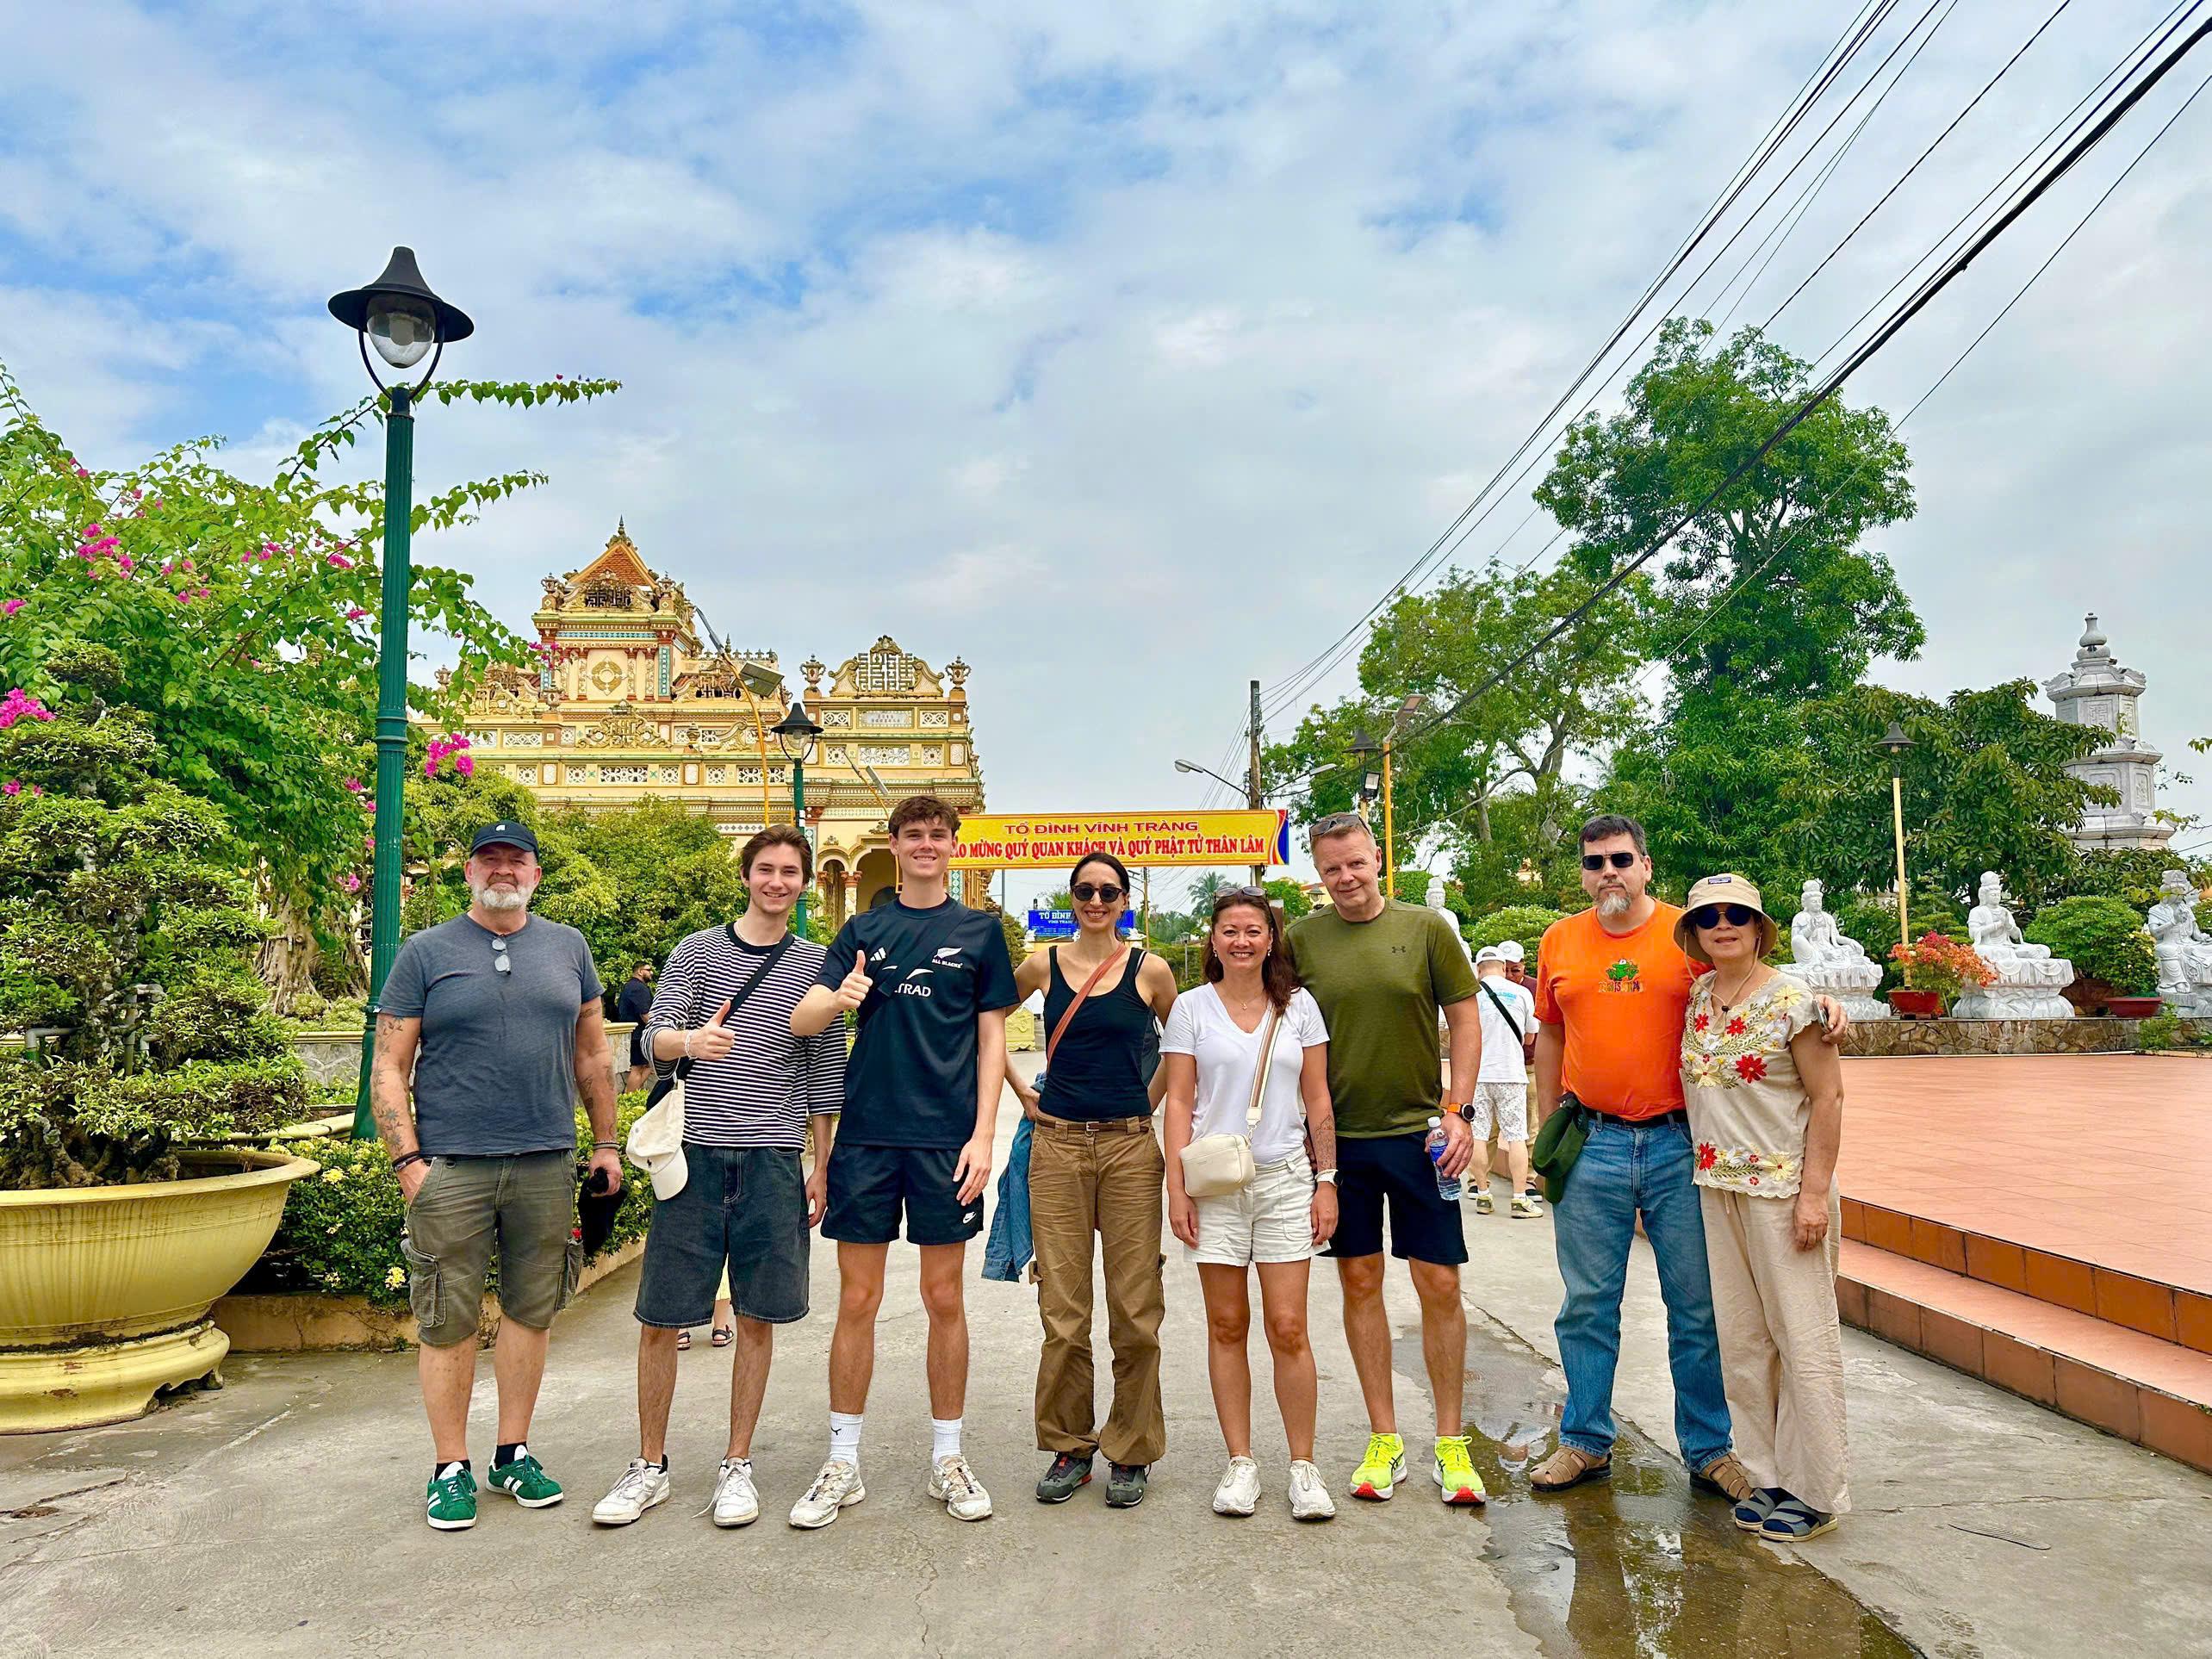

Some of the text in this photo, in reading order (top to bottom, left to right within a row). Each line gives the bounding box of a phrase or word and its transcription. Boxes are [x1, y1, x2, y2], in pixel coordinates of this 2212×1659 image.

[1035, 823, 1079, 834] ĐÌNH
[1084, 822, 1128, 833] VĨNH
[1134, 821, 1198, 832] TRÀNG
[970, 840, 1003, 858] MỪNG
[1005, 838, 1028, 860] QUÝ
[1032, 841, 1065, 859] QUAN
[1067, 837, 1106, 856] KHÁCH
[1109, 836, 1125, 855] VÀ
[1128, 836, 1150, 857] QUÝ
[1155, 836, 1185, 858] PHẬT
[1188, 833, 1203, 854] TỬ
[1206, 835, 1238, 854] THÂN
[1240, 834, 1264, 853] LÂM
[895, 984, 931, 997] TRAD
